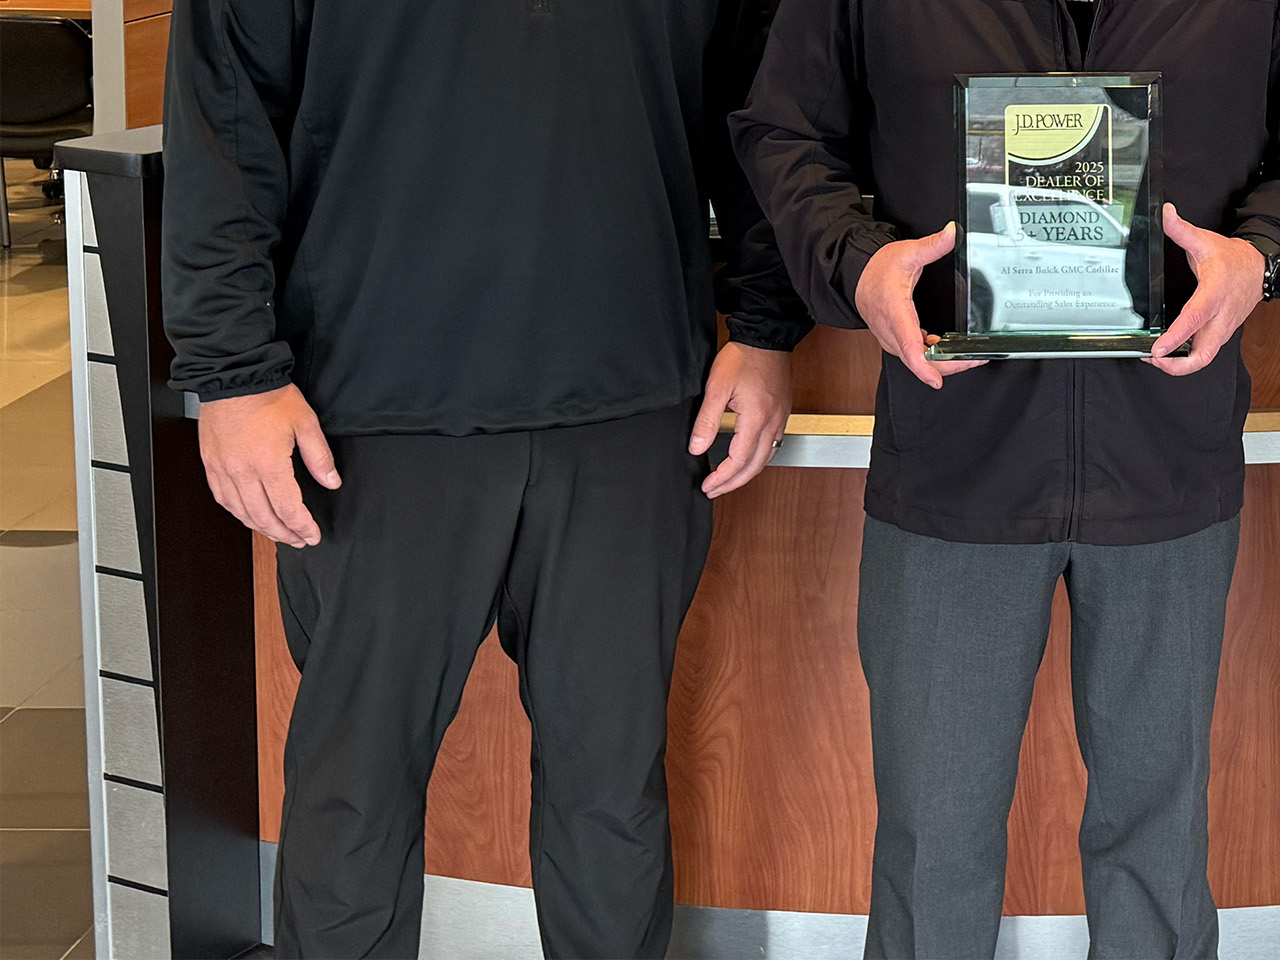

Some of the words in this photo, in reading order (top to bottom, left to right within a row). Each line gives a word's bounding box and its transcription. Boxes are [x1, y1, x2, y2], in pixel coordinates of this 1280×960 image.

[1014, 114, 1034, 136] J.D.
[1036, 114, 1083, 128] POWER
[1075, 162, 1104, 173] 2025
[1026, 176, 1082, 187] DEALER
[1085, 175, 1104, 187] OF
[1020, 212, 1100, 224] DIAMOND
[1043, 227, 1104, 241] YEARS
[1036, 266, 1059, 274] Buick
[1061, 266, 1084, 274] GMC
[1005, 301, 1052, 310] Outstanding
[1054, 300, 1073, 308] Sales
